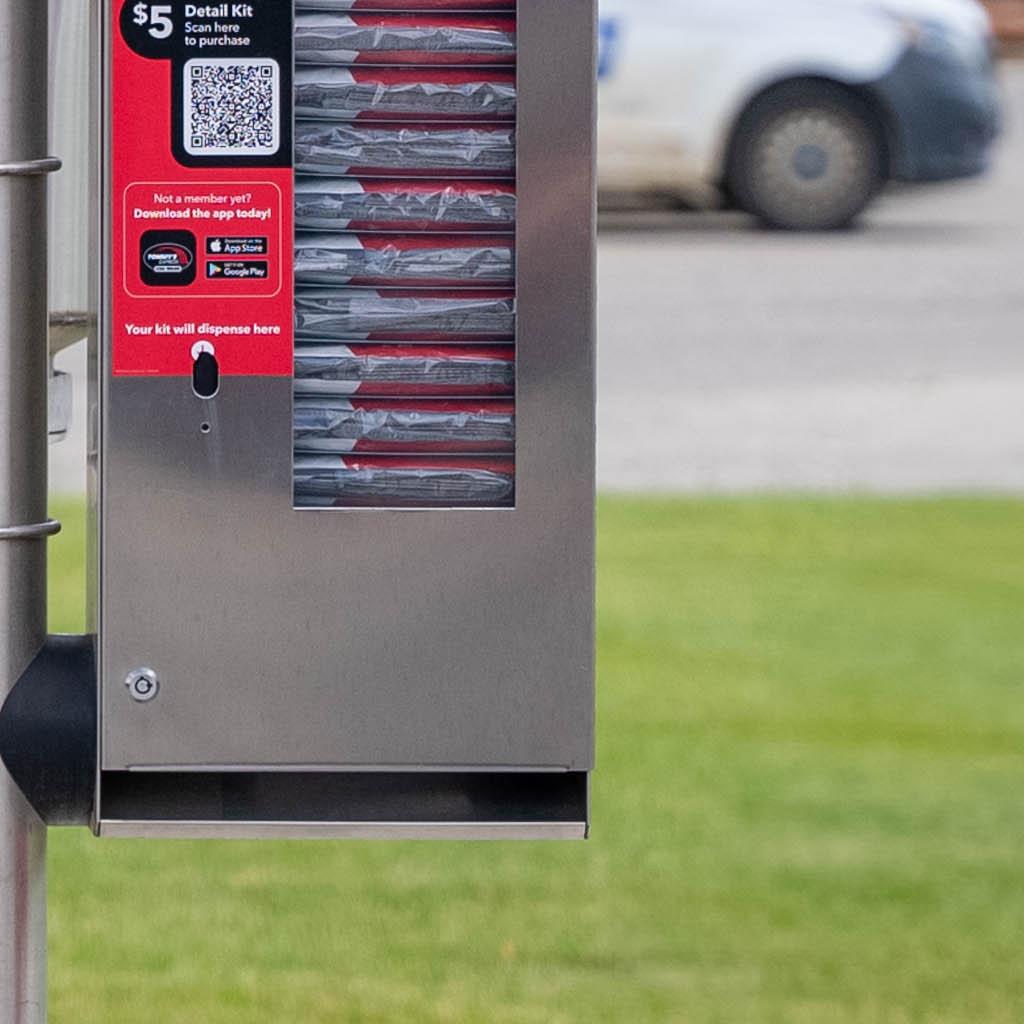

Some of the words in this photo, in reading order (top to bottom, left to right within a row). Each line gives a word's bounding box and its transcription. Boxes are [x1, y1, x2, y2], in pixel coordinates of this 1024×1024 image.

[184, 4, 228, 18] Detail
[232, 4, 254, 18] Kit
[133, 1, 174, 39] $5
[184, 22, 212, 33] Scan
[214, 22, 240, 33] here
[184, 36, 196, 46] to
[199, 36, 250, 48] purchase
[154, 194, 174, 204] Not
[176, 196, 182, 204] a
[184, 194, 228, 204] member
[230, 194, 252, 206] yet?
[134, 208, 190, 219] Download
[192, 208, 211, 219] the
[213, 210, 234, 220] app
[236, 208, 272, 220] today!
[224, 244, 241, 254] App
[242, 244, 263, 252] Store
[224, 268, 249, 277] Google
[250, 268, 265, 276] Play
[125, 324, 152, 335] Your
[155, 324, 171, 335] kit
[174, 324, 195, 335] will
[198, 324, 250, 336] dispense
[253, 324, 280, 335] here
